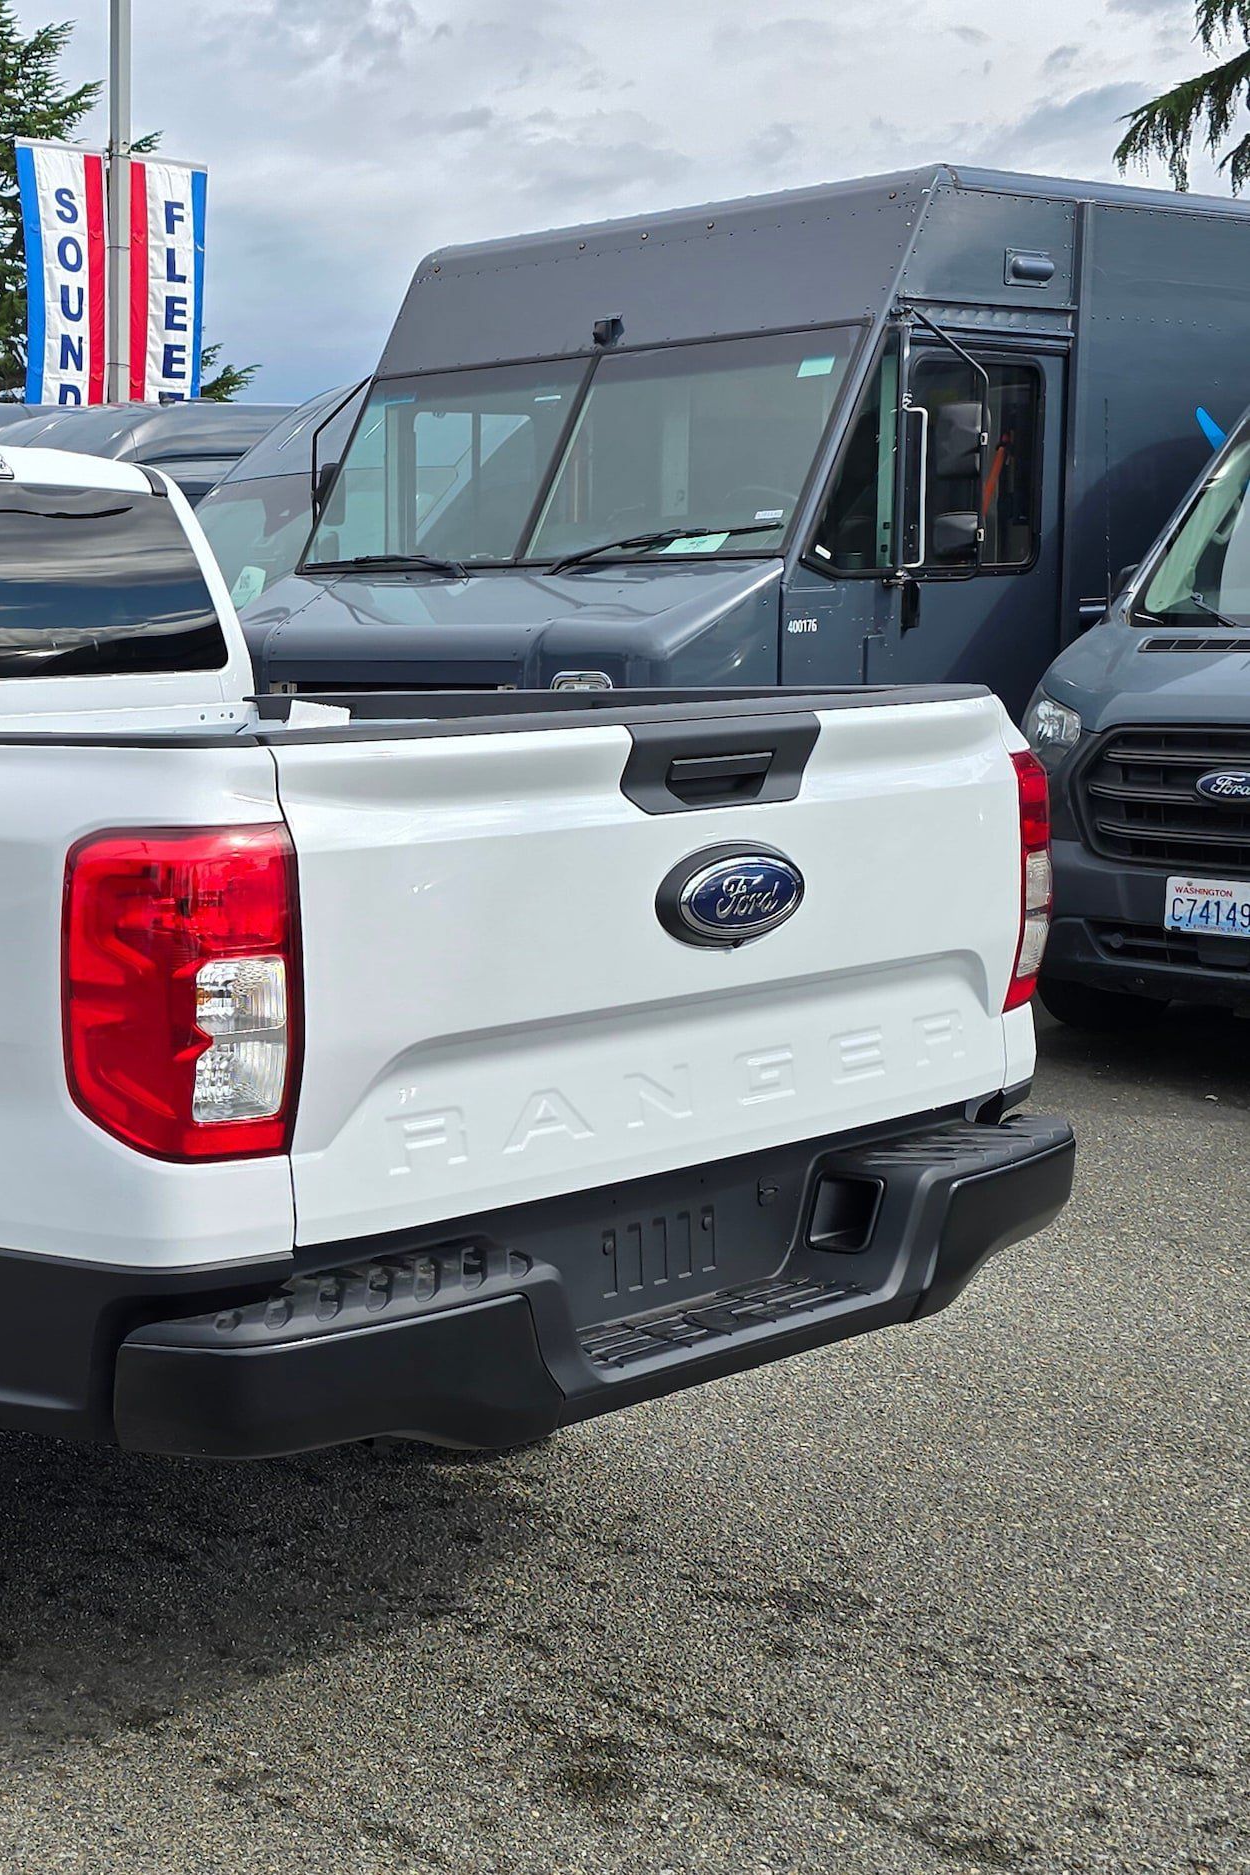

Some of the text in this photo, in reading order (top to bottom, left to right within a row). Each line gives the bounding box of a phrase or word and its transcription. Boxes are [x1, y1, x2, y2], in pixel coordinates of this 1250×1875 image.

[787, 618, 818, 633] 400176
[716, 874, 780, 919] Ford
[1175, 886, 1233, 898] WASHINGTON
[1172, 897, 1250, 928] C74149
[385, 1009, 965, 1176] RANGER
